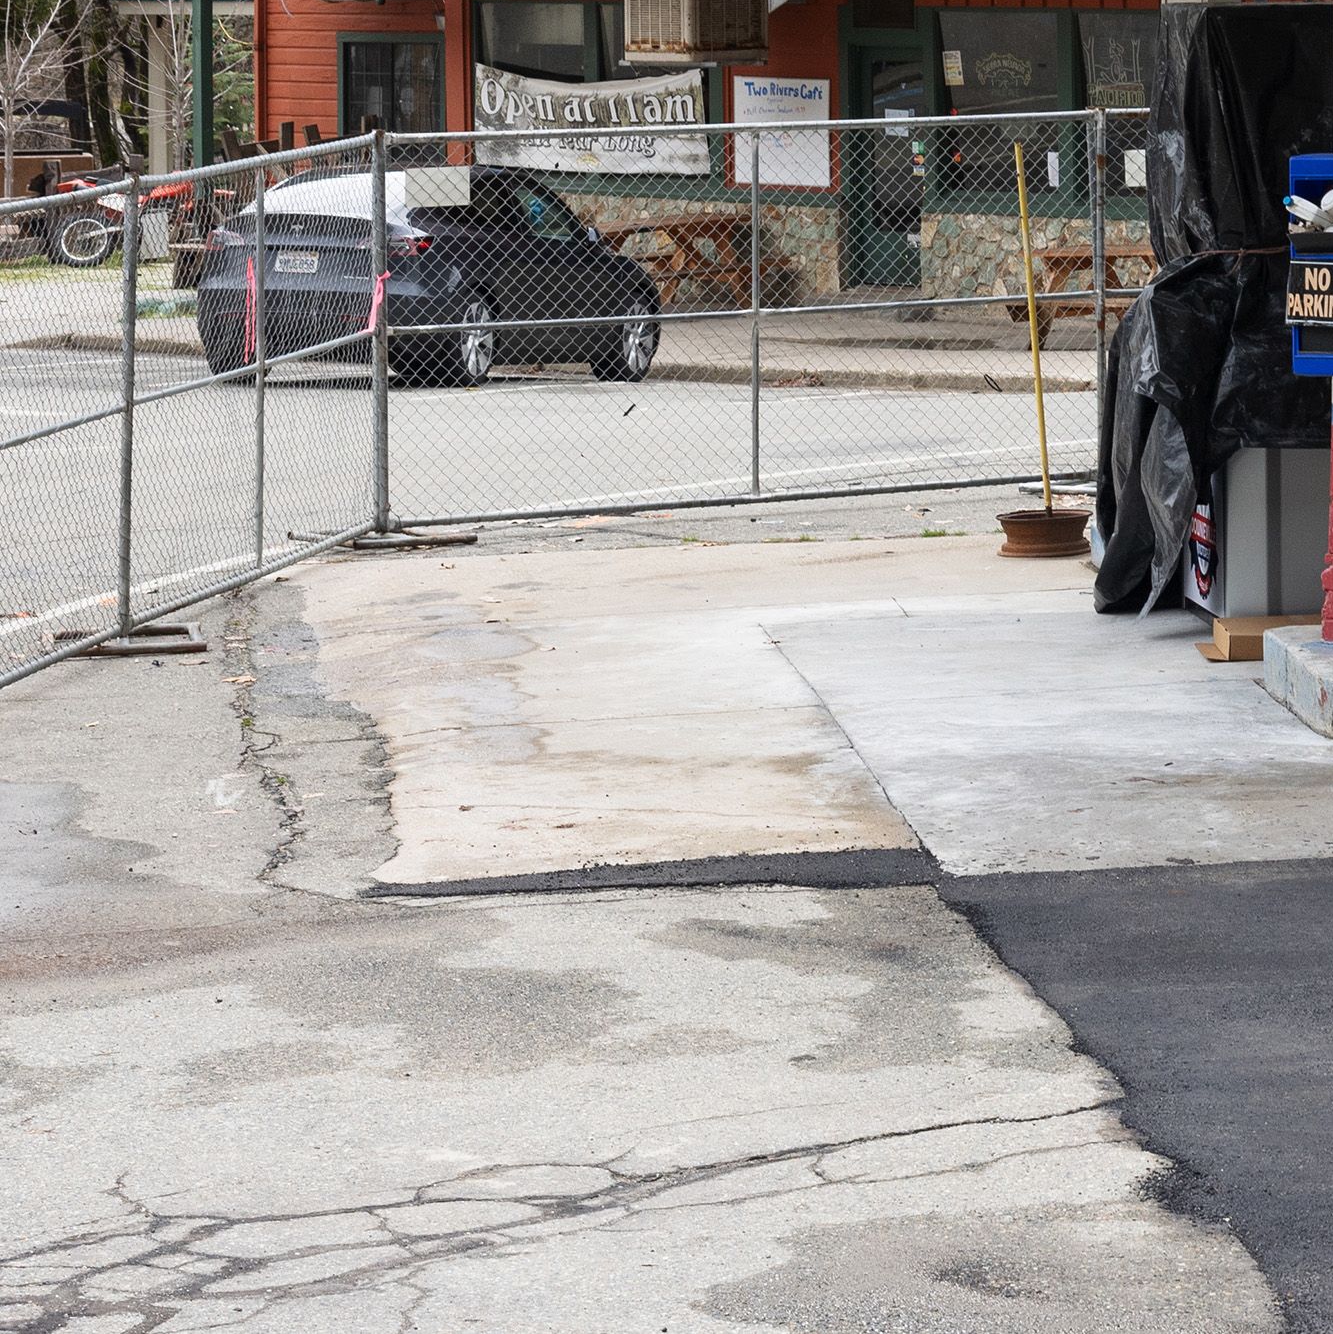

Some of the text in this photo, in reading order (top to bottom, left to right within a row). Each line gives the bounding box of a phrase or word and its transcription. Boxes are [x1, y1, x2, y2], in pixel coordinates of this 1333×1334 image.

[480, 77, 556, 125] Open
[563, 94, 597, 123] at
[744, 81, 768, 96] Two
[770, 82, 799, 97] Rivers
[1304, 267, 1331, 291] NO
